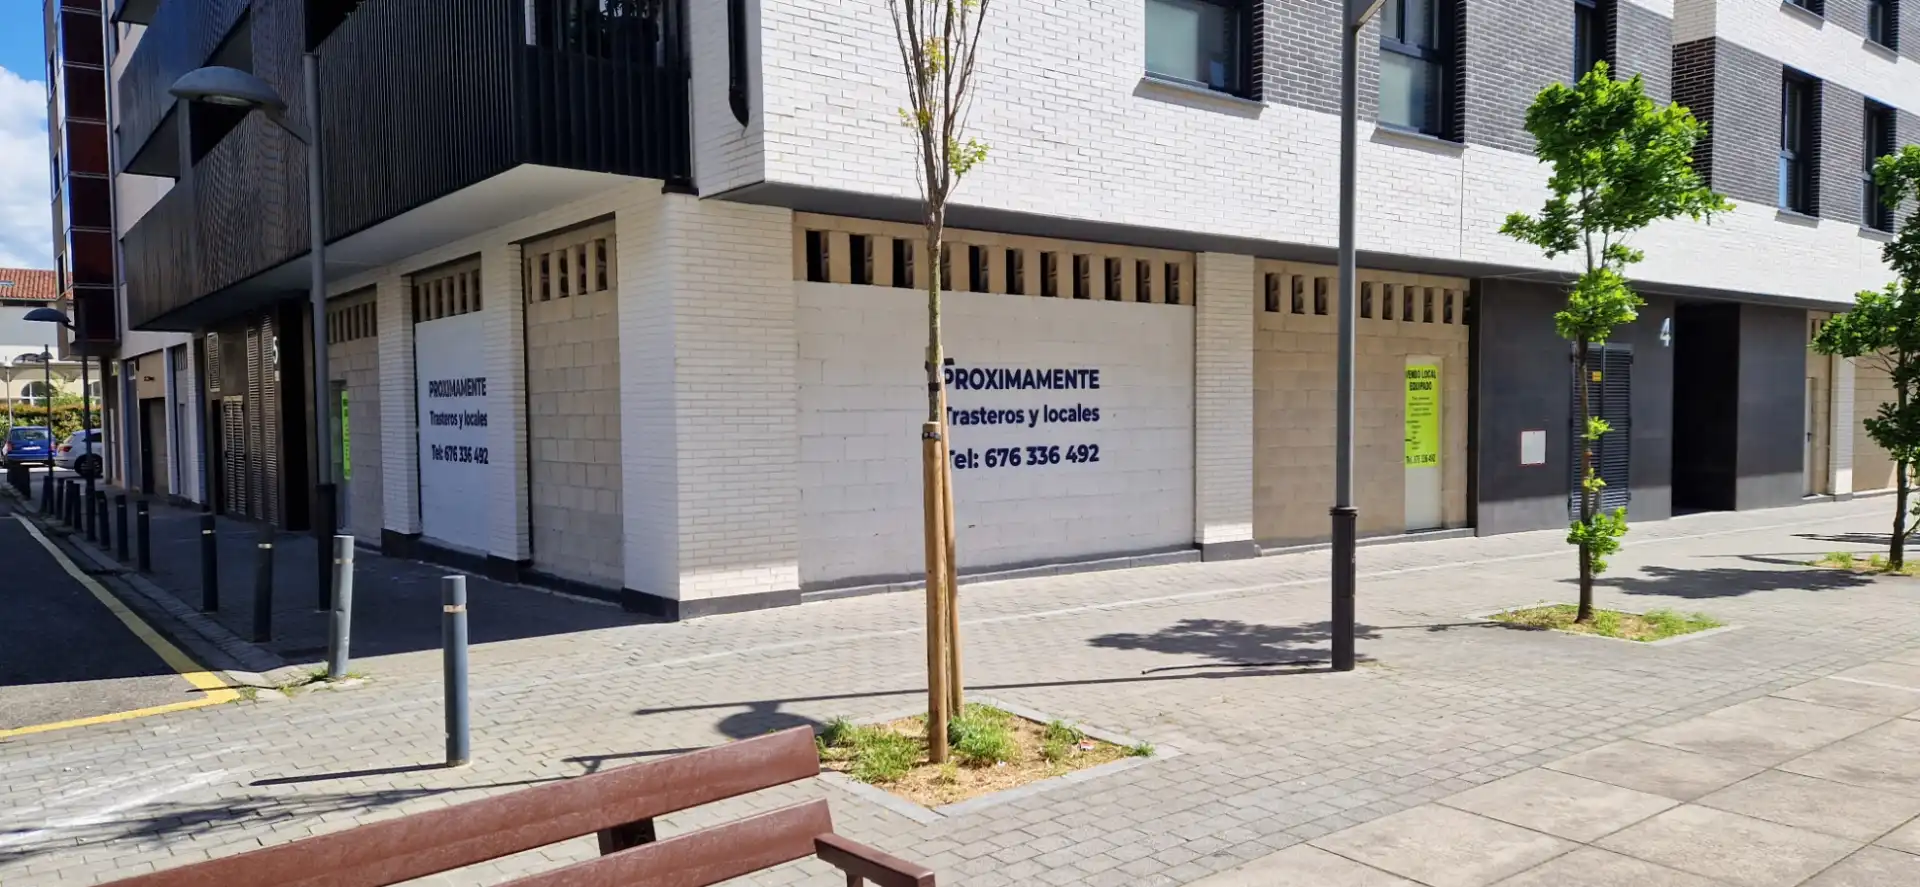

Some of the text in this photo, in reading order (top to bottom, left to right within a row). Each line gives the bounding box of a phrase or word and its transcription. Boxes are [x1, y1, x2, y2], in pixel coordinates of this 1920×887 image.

[1659, 317, 1671, 347] 4
[273, 336, 279, 364] 5
[429, 377, 487, 398] PROXIMAMENTE
[944, 367, 1100, 390] PROXIMAMENTE
[430, 409, 488, 430] Trasteros y locales
[1028, 409, 1039, 428] y
[1044, 403, 1100, 423] locales
[432, 444, 489, 465] Tel: 676 336 492
[985, 447, 1022, 468] 676
[1026, 445, 1060, 466] 336
[1065, 443, 1099, 463] 492
